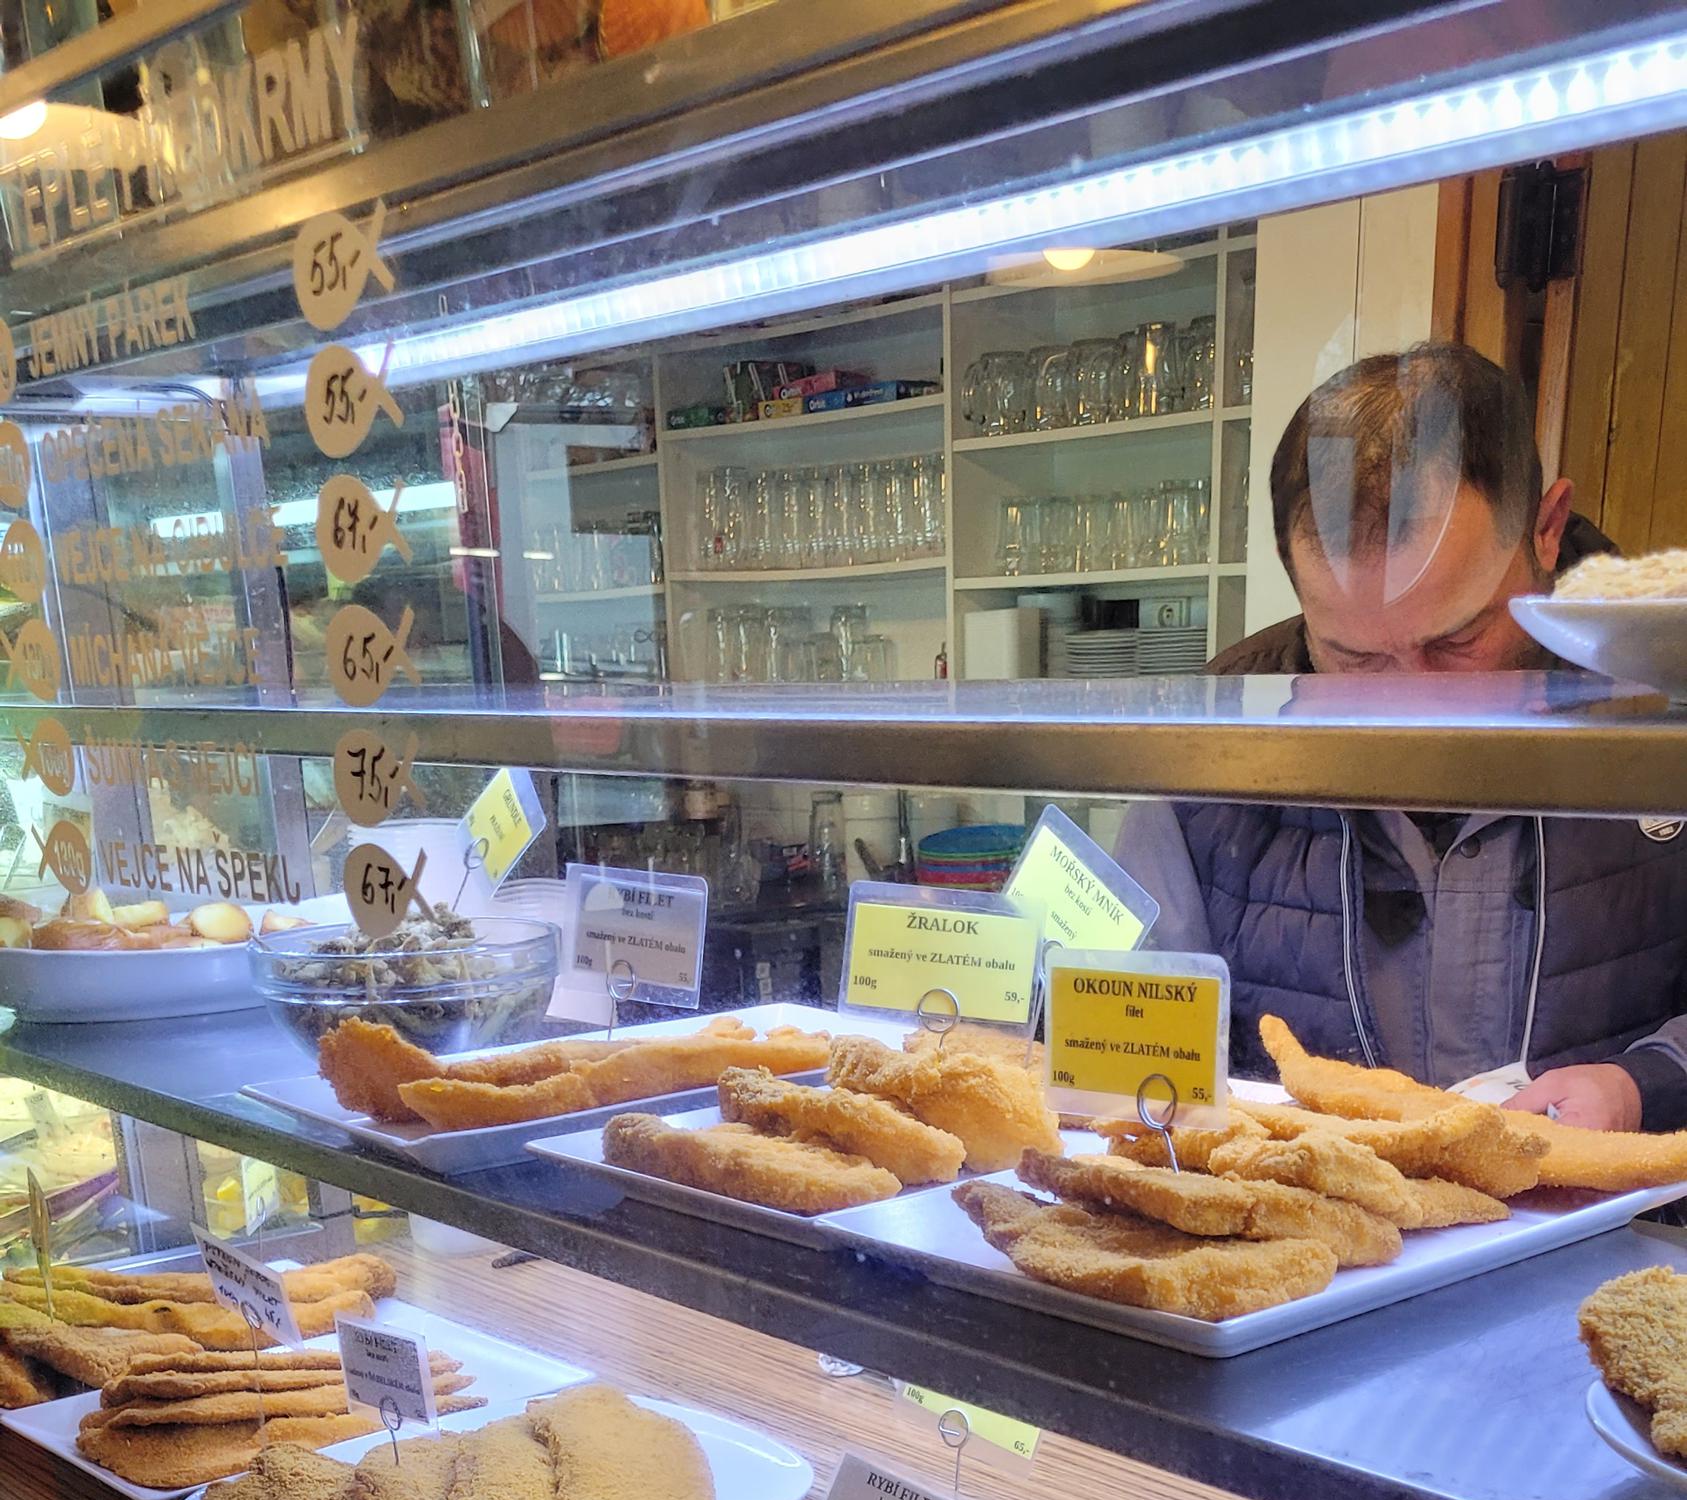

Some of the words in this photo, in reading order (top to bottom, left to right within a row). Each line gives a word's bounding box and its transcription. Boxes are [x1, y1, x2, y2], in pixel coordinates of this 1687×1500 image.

[310, 231, 361, 296] 55,-
[323, 367, 367, 425] 55,-
[342, 631, 395, 685] 65,-
[347, 746, 399, 808] 75,-
[100, 840, 174, 893] VEJCE
[176, 845, 212, 896] NA
[361, 862, 407, 915] 67,-
[1050, 845, 1095, 895] MOŘSKÝ
[1094, 889, 1124, 925] MNÍK
[1064, 883, 1076, 899] bez
[1075, 896, 1092, 916] kostí
[906, 912, 979, 936] ŽRALOK
[1050, 910, 1078, 941] smažený
[627, 934, 664, 952] ZLATÉM
[867, 947, 914, 963] smažený
[915, 953, 928, 963] ve
[929, 951, 982, 968] ZLATÉM
[985, 959, 1016, 972] obalu
[852, 974, 878, 990] 100g
[1073, 977, 1134, 998] OKOUN
[1136, 981, 1199, 1003] NILSKÝ
[1004, 991, 1025, 1005] 59,-
[1125, 1003, 1144, 1019] filet
[1064, 1036, 1107, 1054] smažený
[1110, 1043, 1121, 1052] ve
[1122, 1041, 1170, 1059] ZLATÉM
[1173, 1048, 1201, 1062] obalu
[1052, 1069, 1075, 1086] 100g
[1191, 1087, 1212, 1102] 55,-
[906, 1385, 925, 1405] 100g
[1013, 1439, 1030, 1455] 65,-
[866, 1470, 900, 1499] RYBÍ
